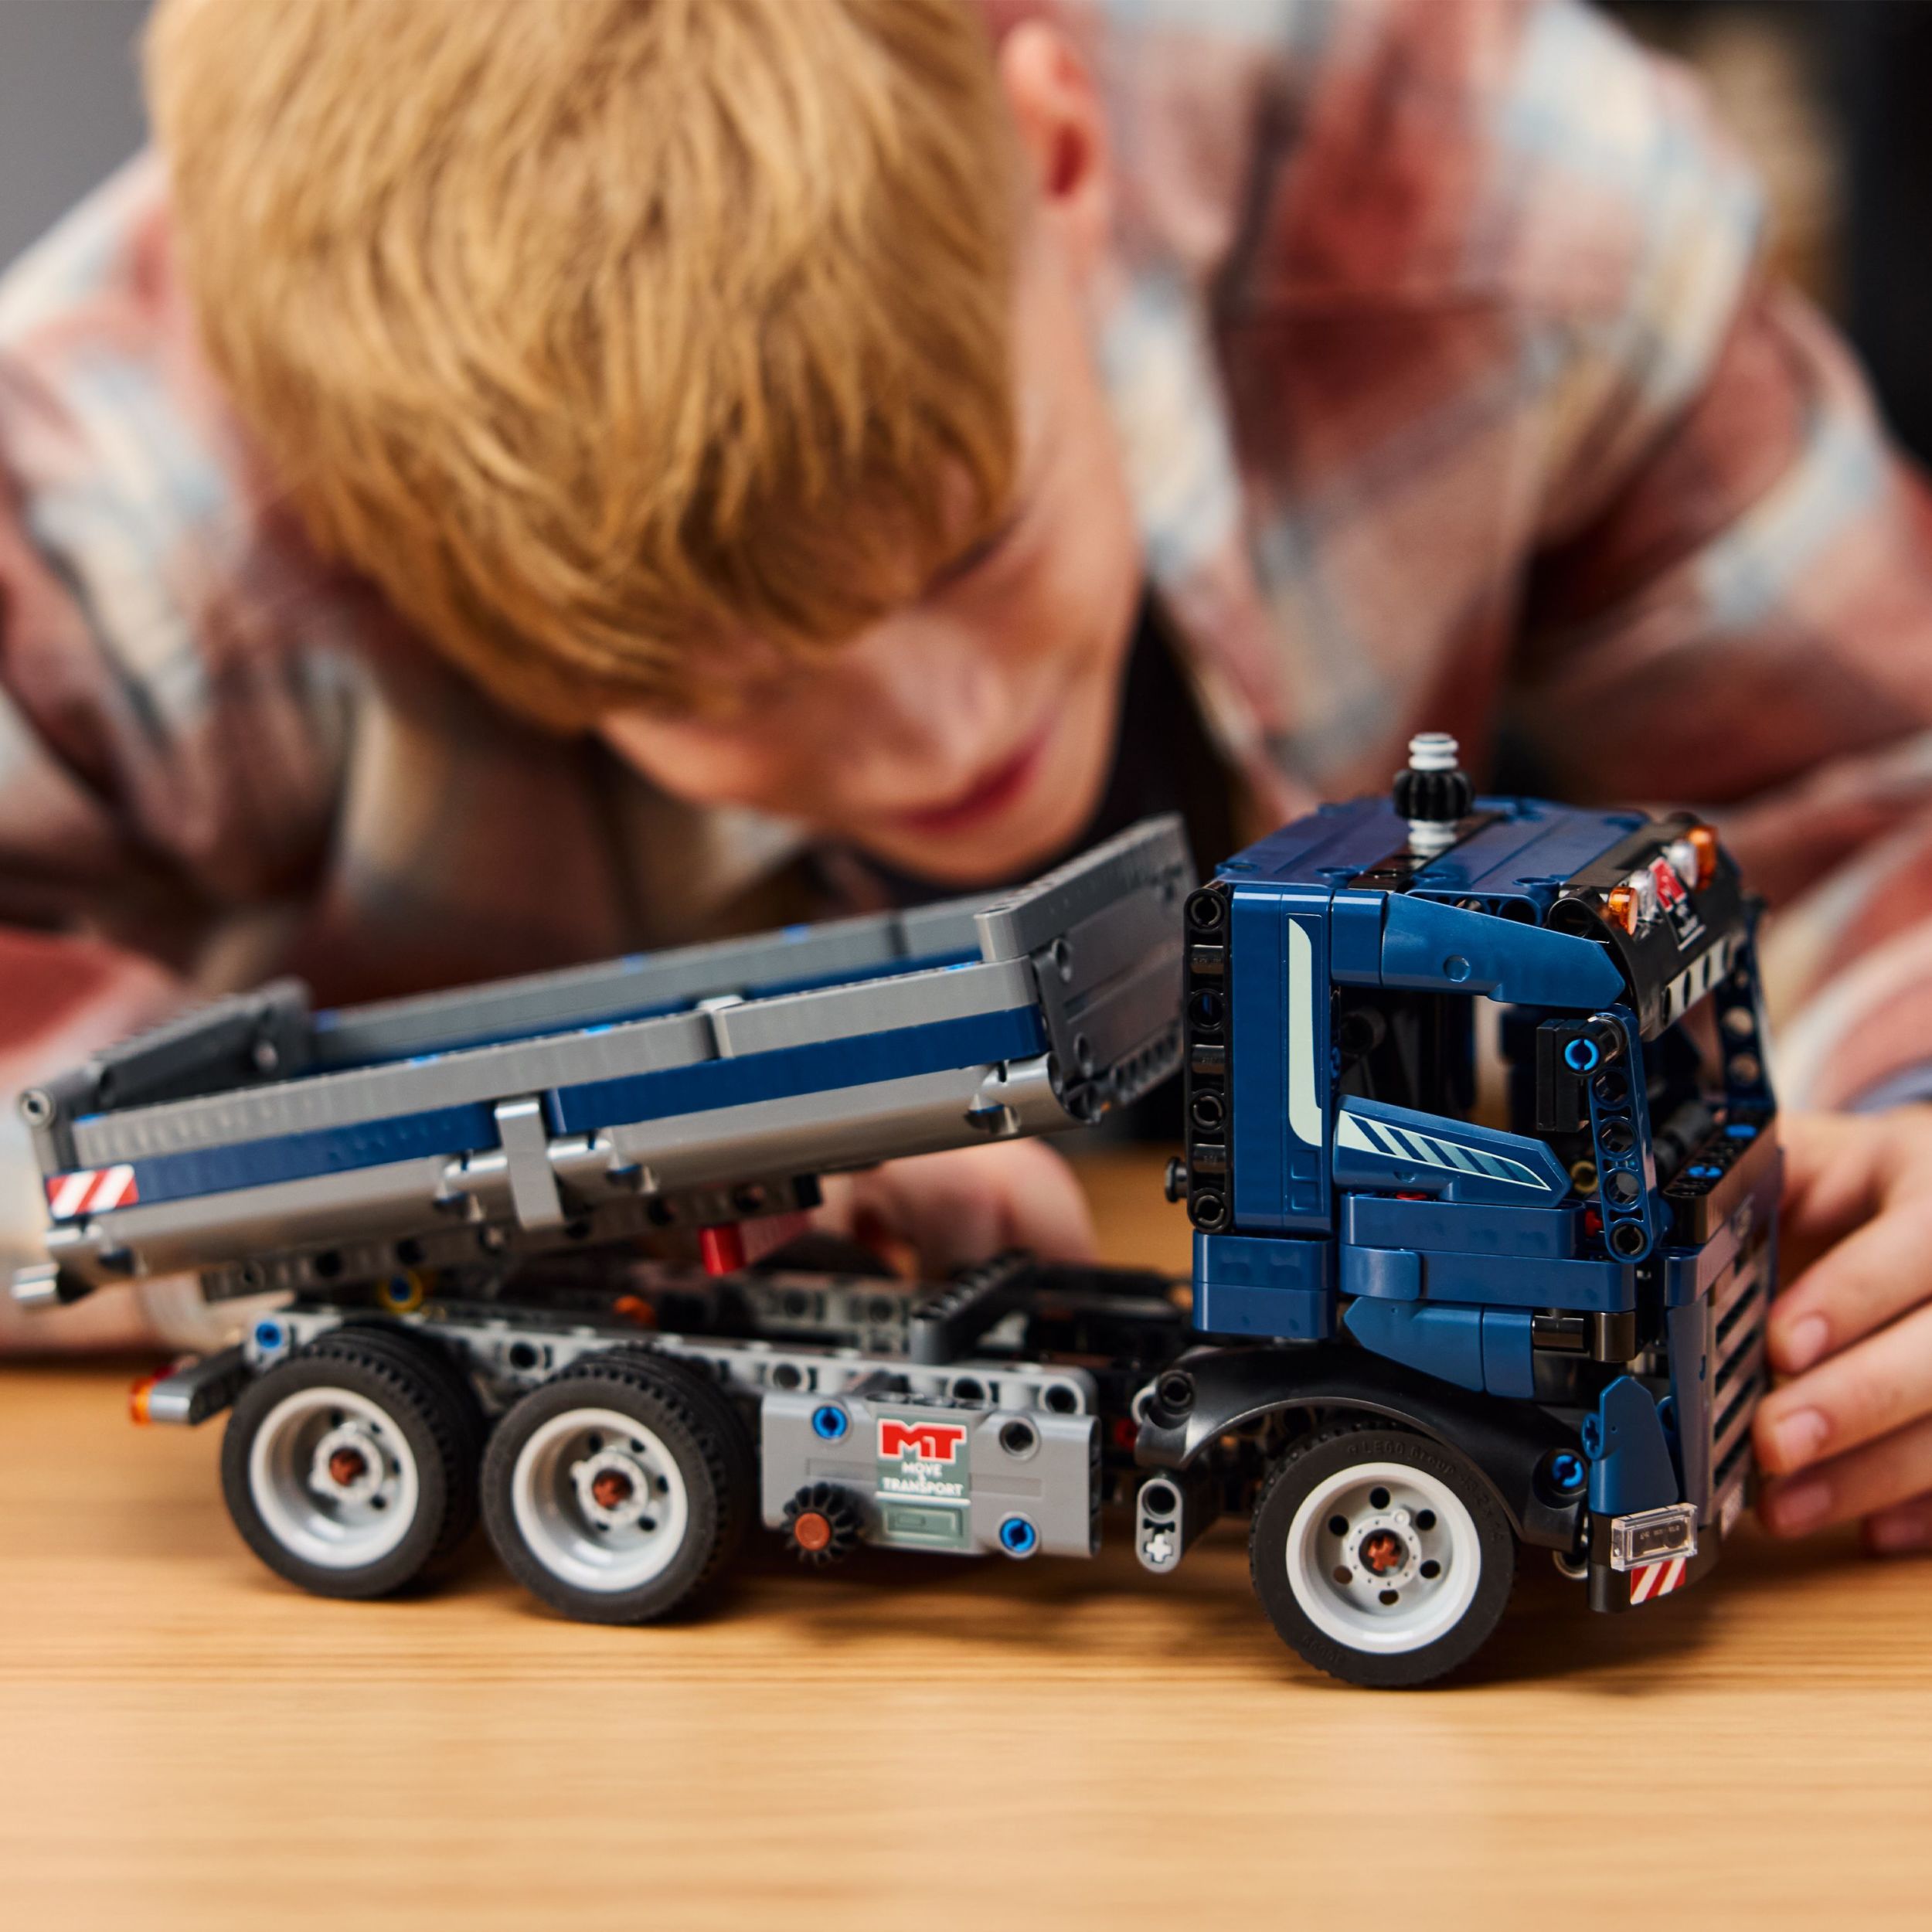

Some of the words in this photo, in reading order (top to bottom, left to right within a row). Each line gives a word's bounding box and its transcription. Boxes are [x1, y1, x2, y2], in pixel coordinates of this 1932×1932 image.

[879, 1419, 966, 1463] MT
[901, 1462, 943, 1477] MOVE
[1362, 1440, 1404, 1454] LEGO
[1410, 1445, 1456, 1474] Group
[882, 1477, 964, 1496] TRANSPORT
